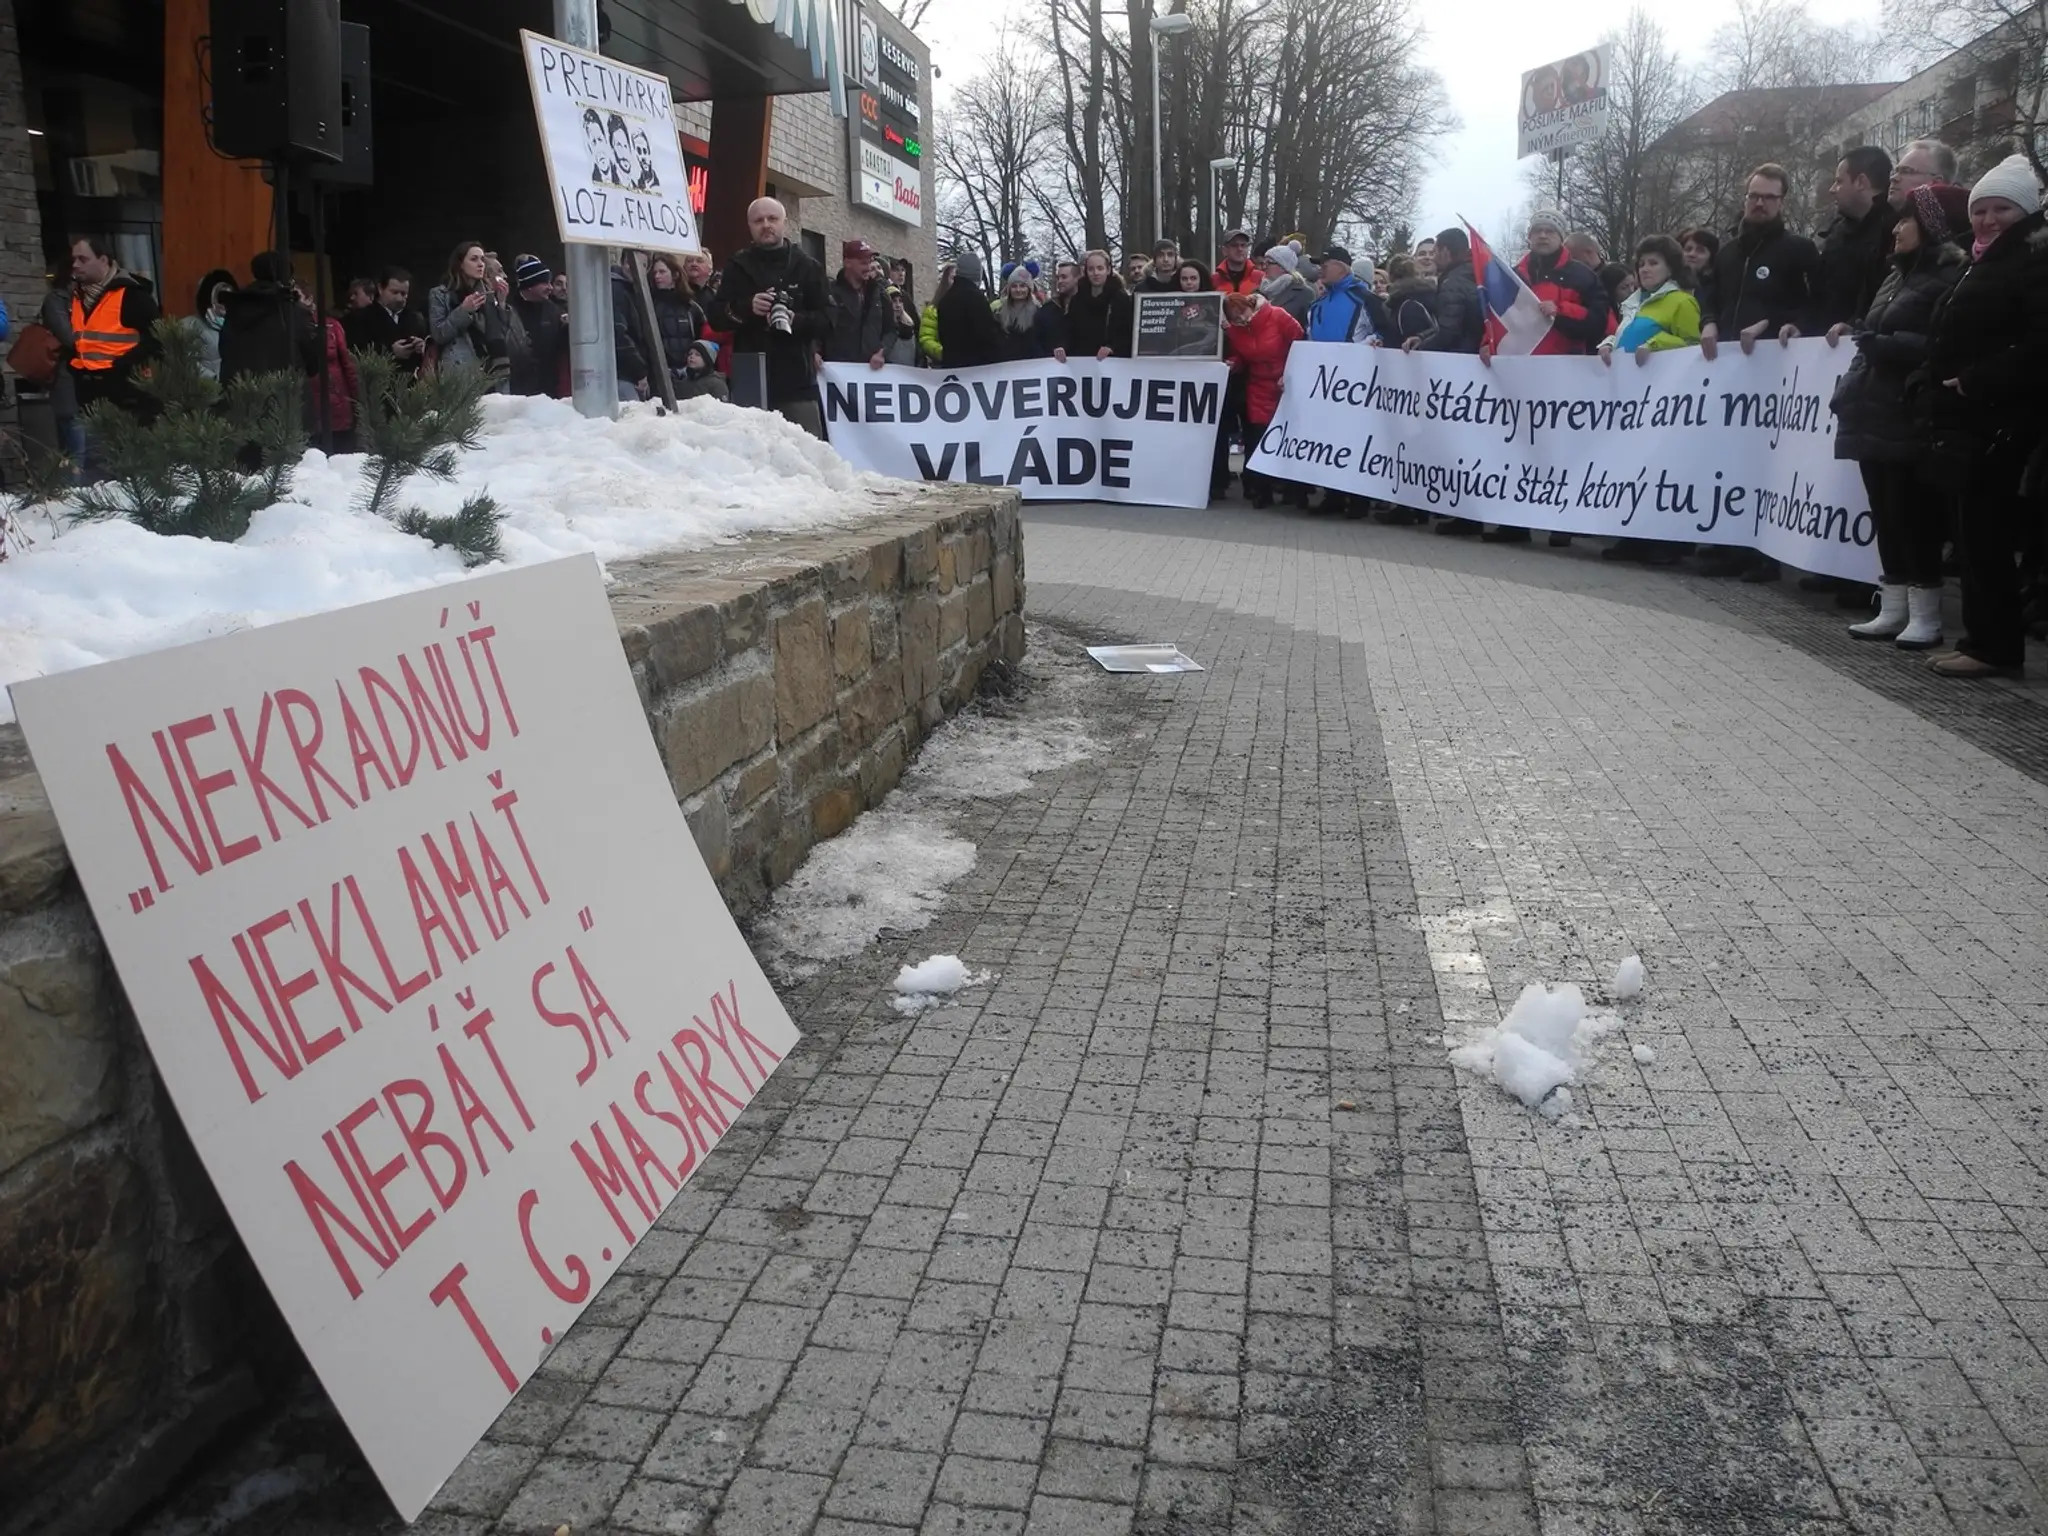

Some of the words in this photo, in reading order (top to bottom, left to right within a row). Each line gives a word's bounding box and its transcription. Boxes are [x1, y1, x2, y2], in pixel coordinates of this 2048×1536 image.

[881, 36, 920, 81] RESERVED
[861, 92, 878, 120] CCC
[1569, 95, 1607, 120] MAFIU
[561, 186, 615, 228] LOŽ
[625, 197, 690, 239] FALOŠ
[894, 176, 921, 210] Bata
[1142, 298, 1186, 308] Slovensko
[826, 374, 1220, 424] NEDÔVERUJEM
[1309, 364, 1421, 419] Nechceme
[1425, 378, 1522, 445] štátny
[1526, 385, 1652, 446] prevrat
[1650, 377, 1708, 428] ani
[910, 425, 1134, 489] VLÁDE
[1260, 421, 1352, 470] Chceme
[1514, 463, 1570, 514] štát,
[1576, 461, 1648, 527] ktorý
[1655, 469, 1699, 514] tu
[1696, 470, 1747, 533] je
[189, 770, 551, 1104] NEKLAMAŤ
[283, 984, 538, 1302] NEBÁŤ
